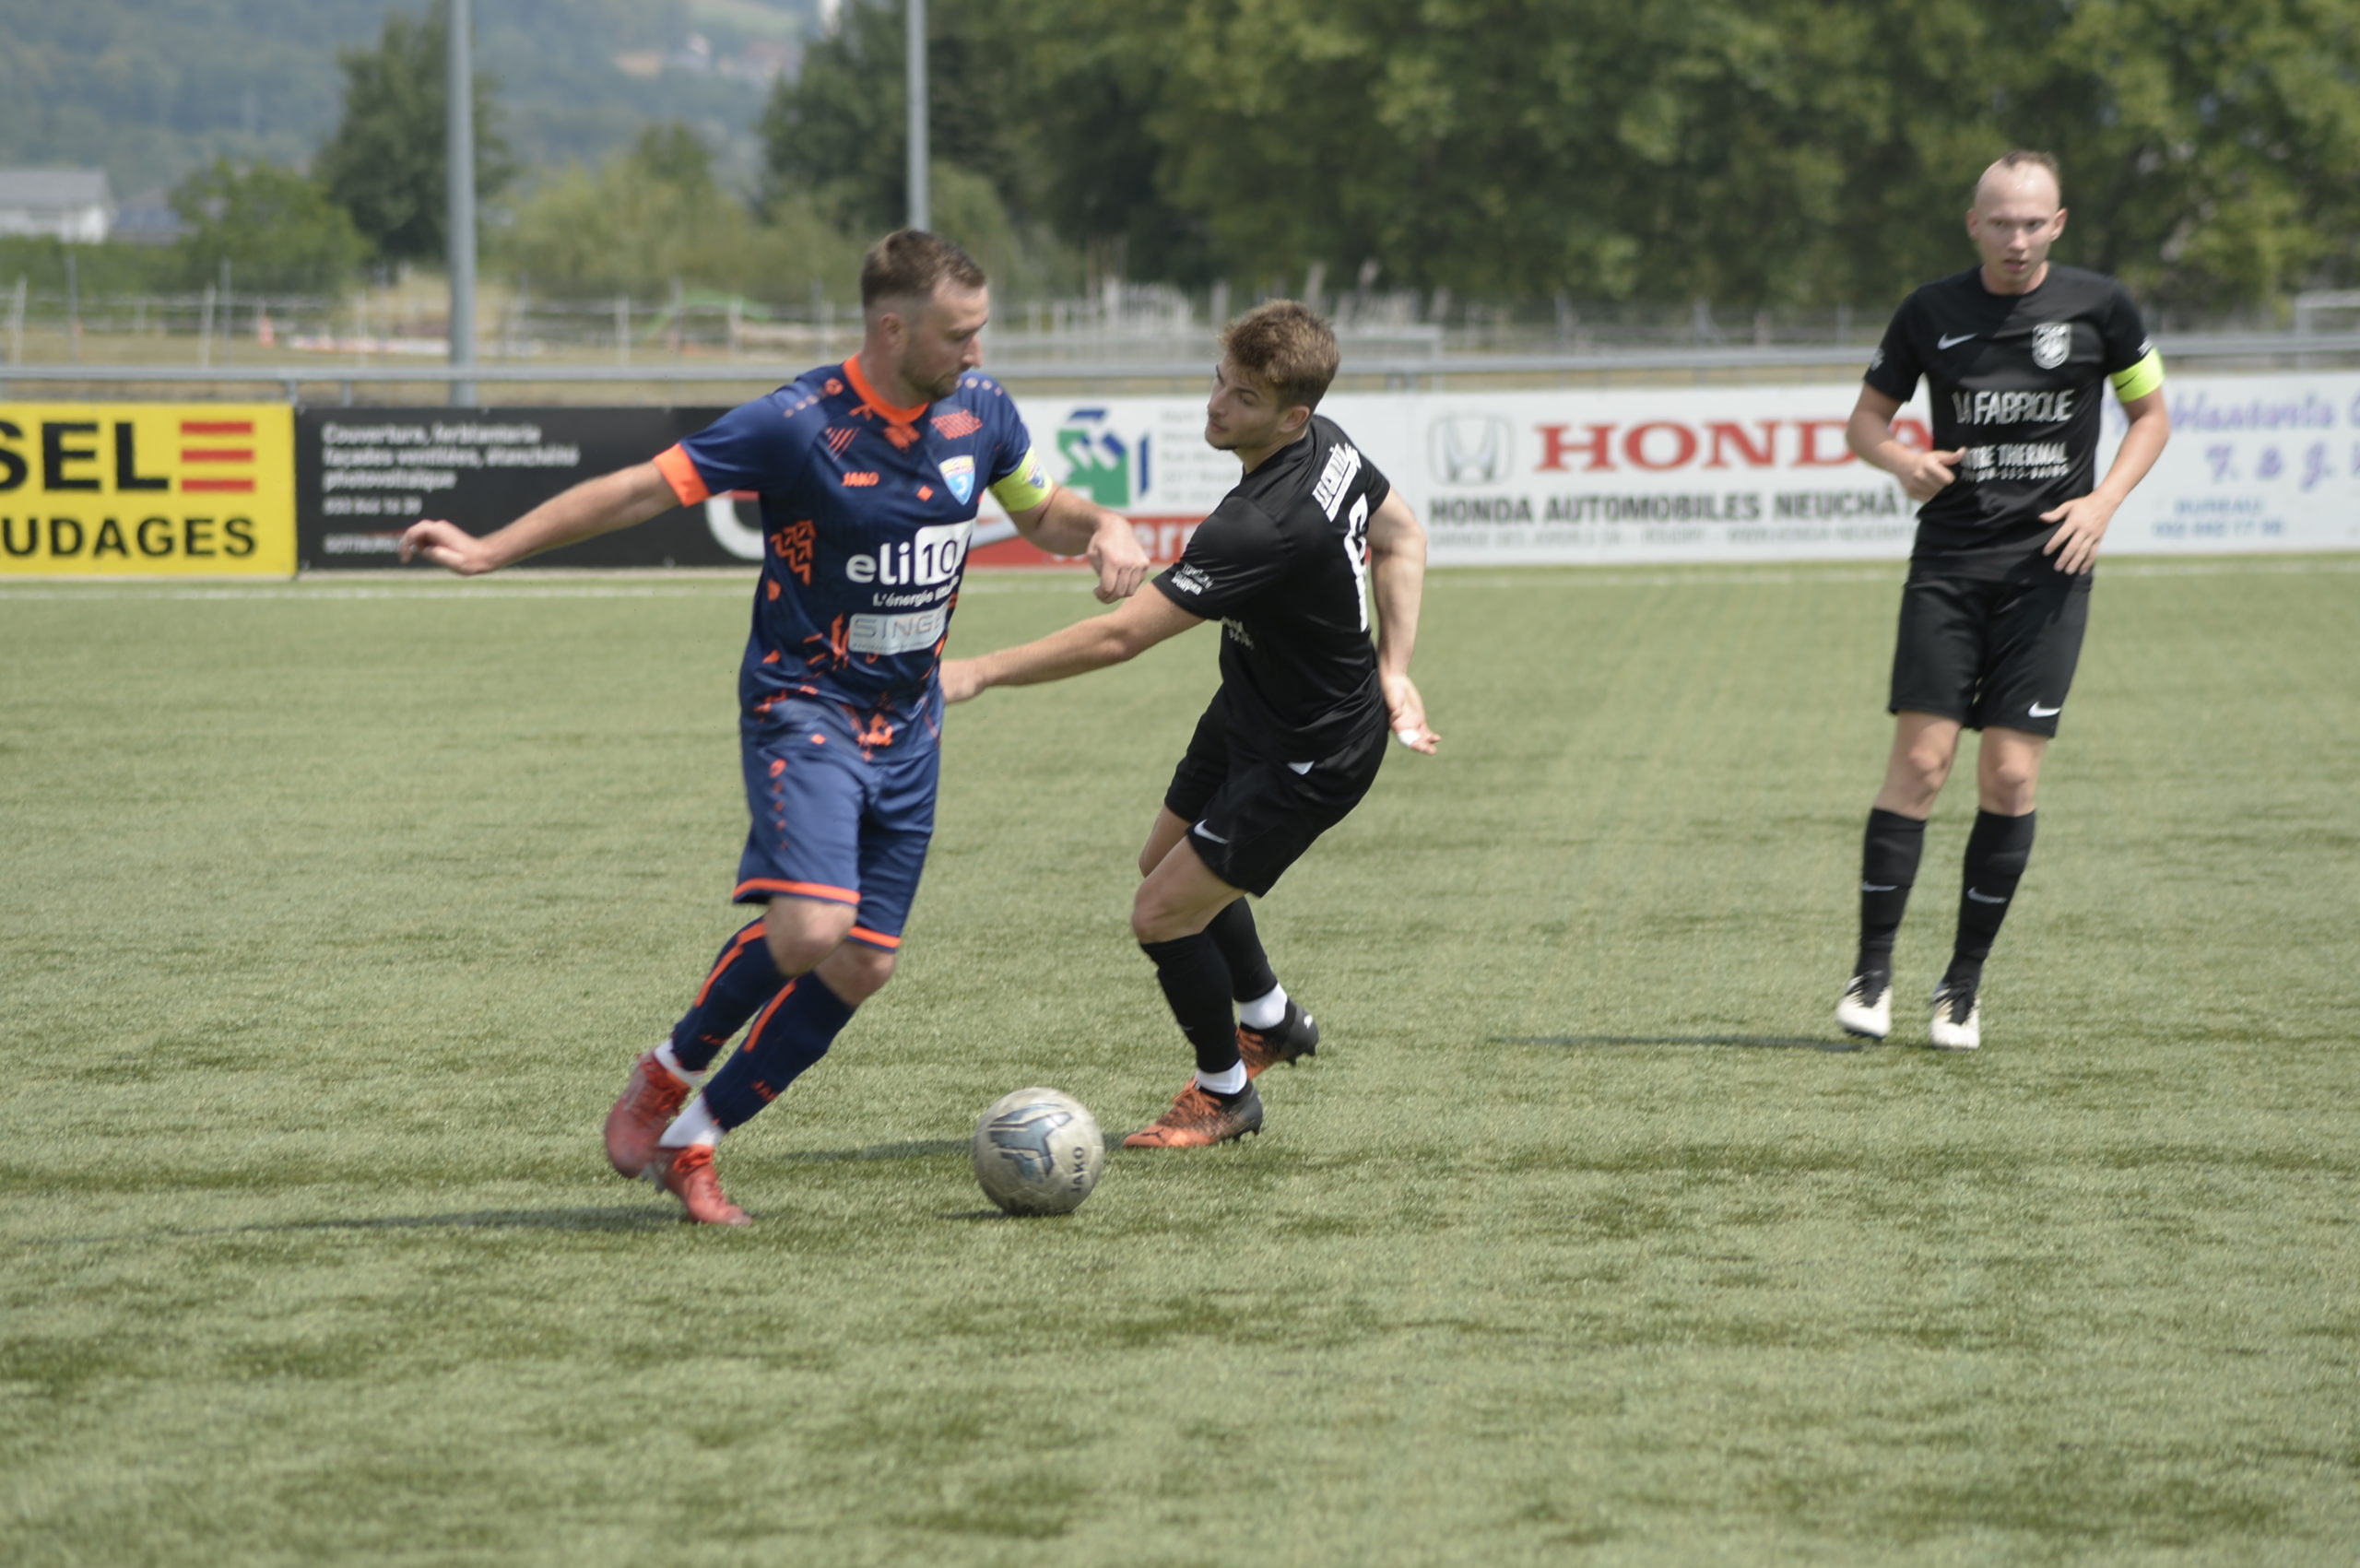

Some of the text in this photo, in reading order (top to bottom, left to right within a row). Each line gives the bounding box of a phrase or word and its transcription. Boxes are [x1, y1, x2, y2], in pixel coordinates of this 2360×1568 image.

[1974, 388, 2075, 425] FABRIQUE
[1429, 497, 1533, 525] HONDA
[1544, 491, 1760, 522] AUTOMOBILES
[1, 516, 256, 559] UDAGES
[845, 539, 957, 586] eli10
[1070, 1146, 1085, 1193] JAKO
